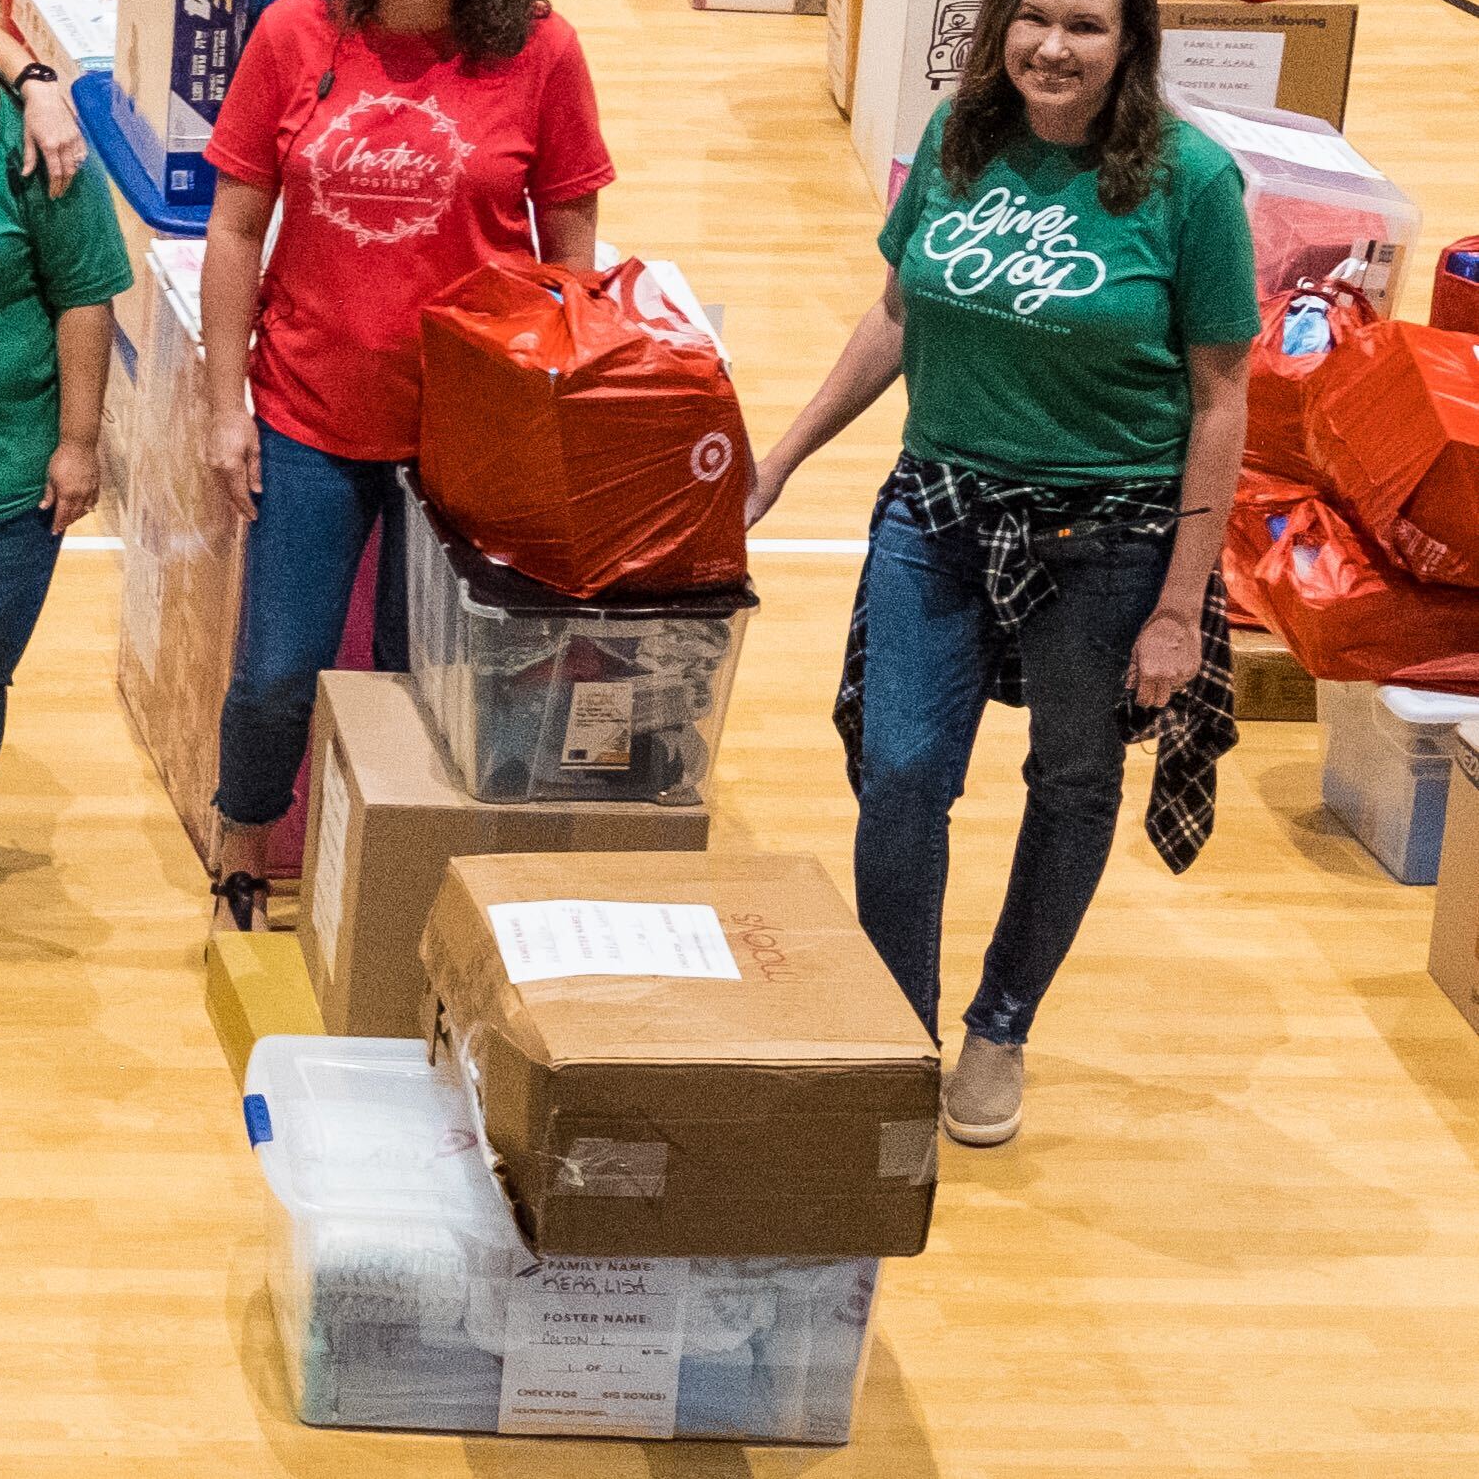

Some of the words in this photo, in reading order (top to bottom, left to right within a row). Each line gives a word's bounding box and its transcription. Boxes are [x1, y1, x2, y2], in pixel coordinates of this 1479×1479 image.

[349, 177, 420, 189] FOSTERS
[548, 1261, 601, 1271] FAMILY
[544, 1313, 599, 1322] FOSTER
